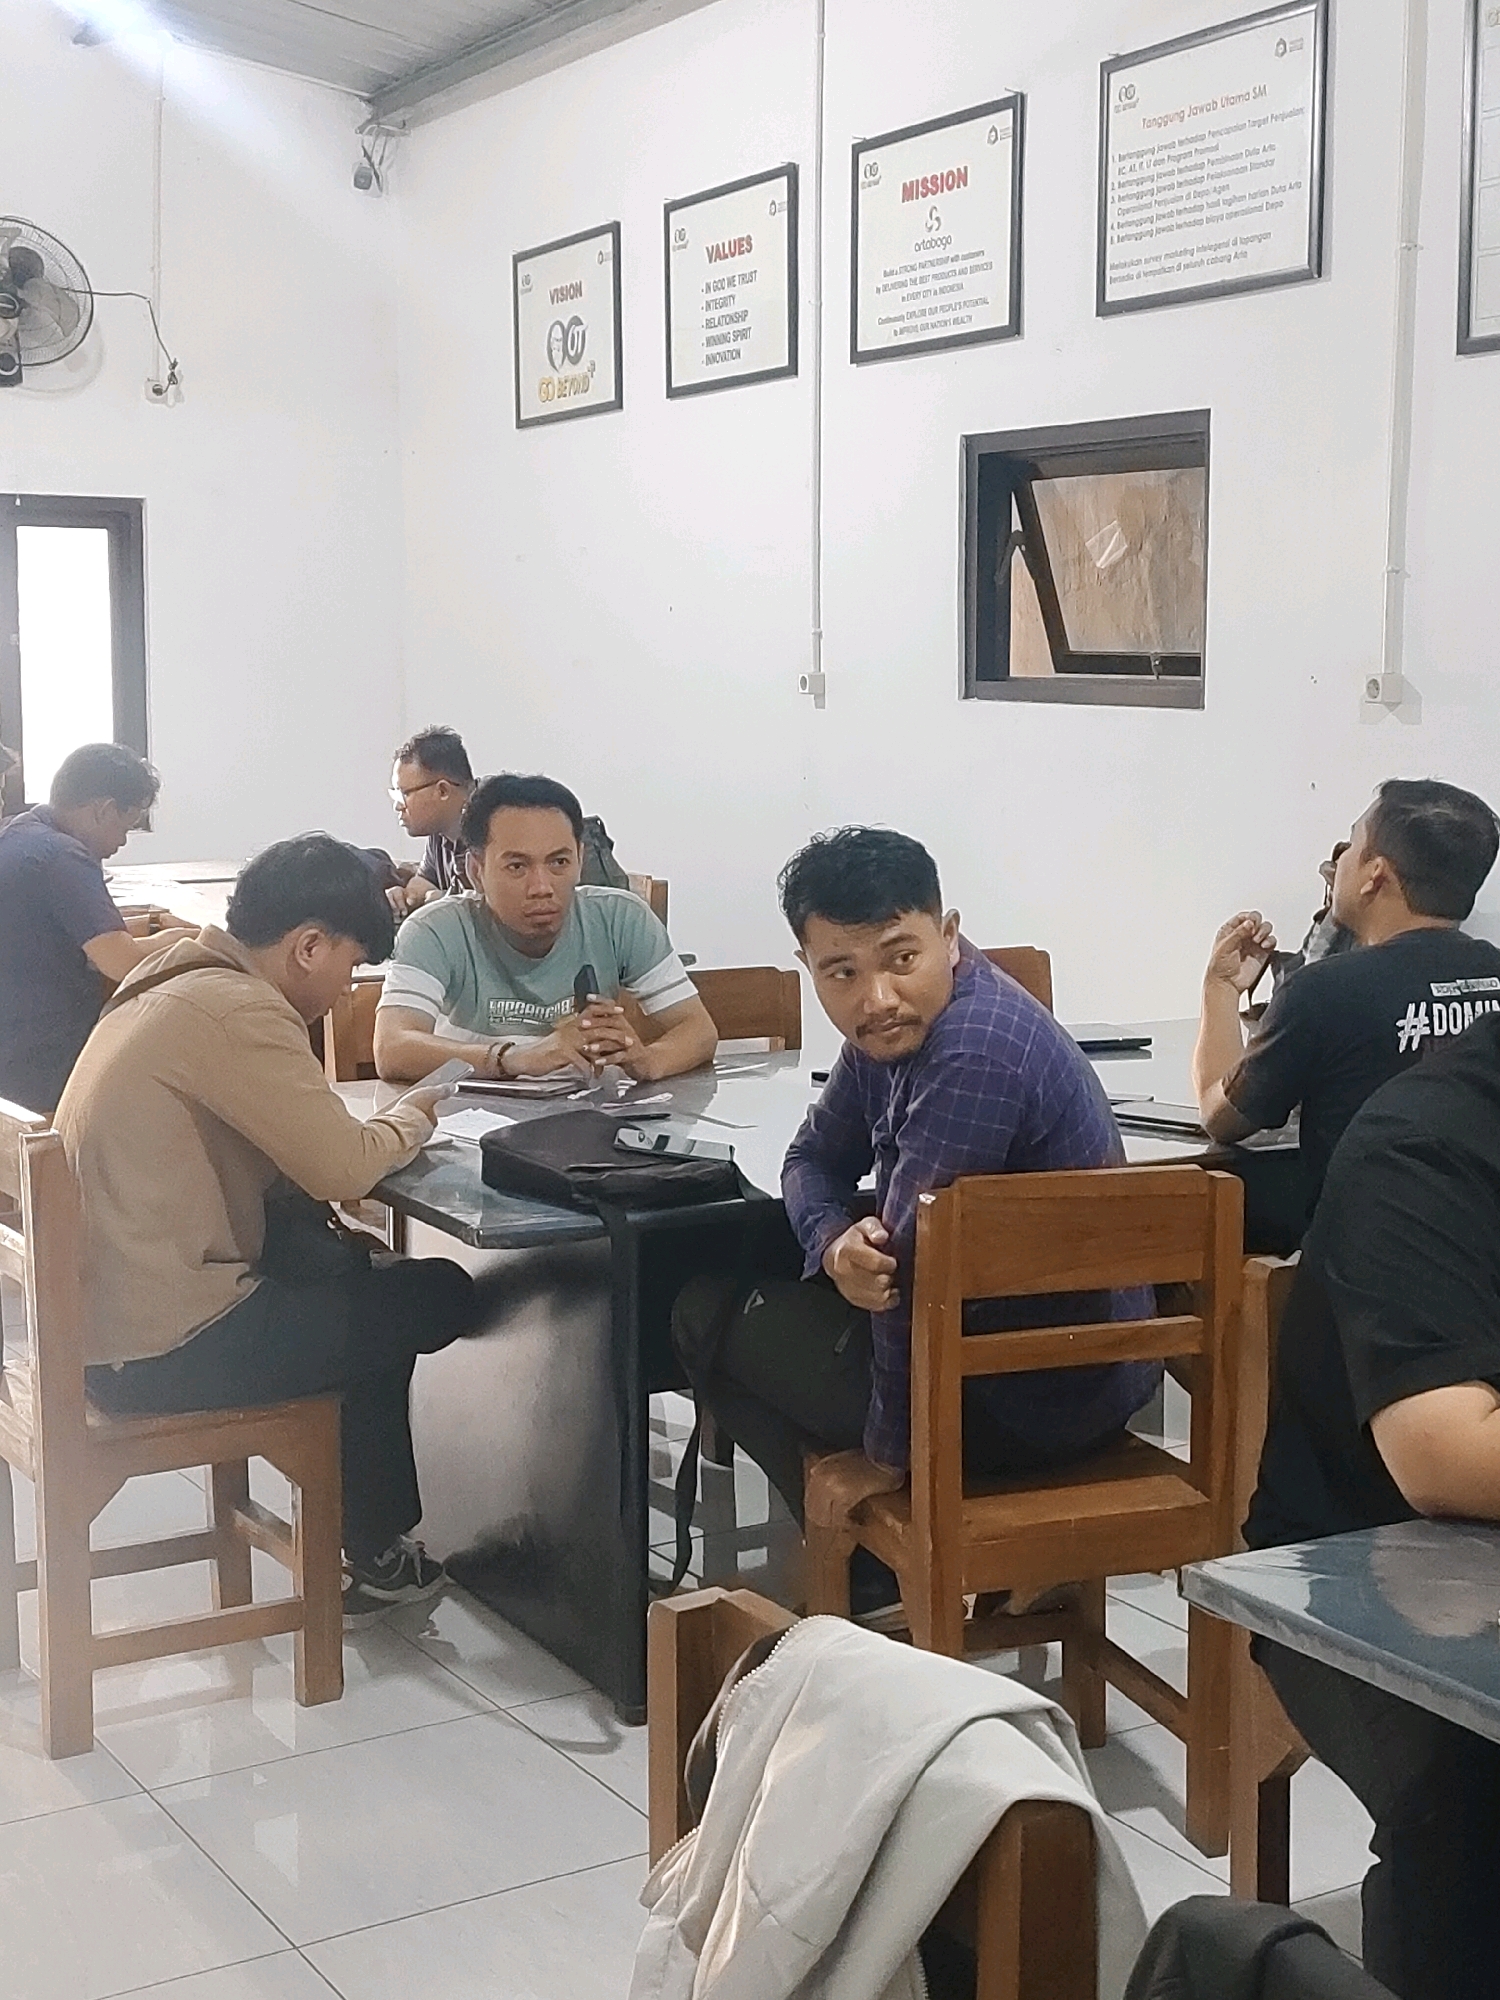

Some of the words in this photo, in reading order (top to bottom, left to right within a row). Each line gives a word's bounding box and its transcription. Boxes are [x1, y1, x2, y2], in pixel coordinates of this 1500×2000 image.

[1142, 110, 1185, 129] Tanggung
[1187, 99, 1218, 118] Jawab
[1221, 92, 1250, 108] Utama
[1252, 84, 1267, 100] SM
[901, 165, 968, 203] MISSION
[706, 234, 753, 264] VALUES
[549, 280, 583, 305] VISION
[712, 277, 726, 293] GOD
[737, 270, 758, 286] TRUST
[705, 294, 736, 312] INTEGRITY
[705, 309, 749, 330] RELATIONSHIP
[705, 331, 731, 348] WINNING
[732, 327, 752, 343] SPIRIT
[705, 348, 741, 367] INNOVATION
